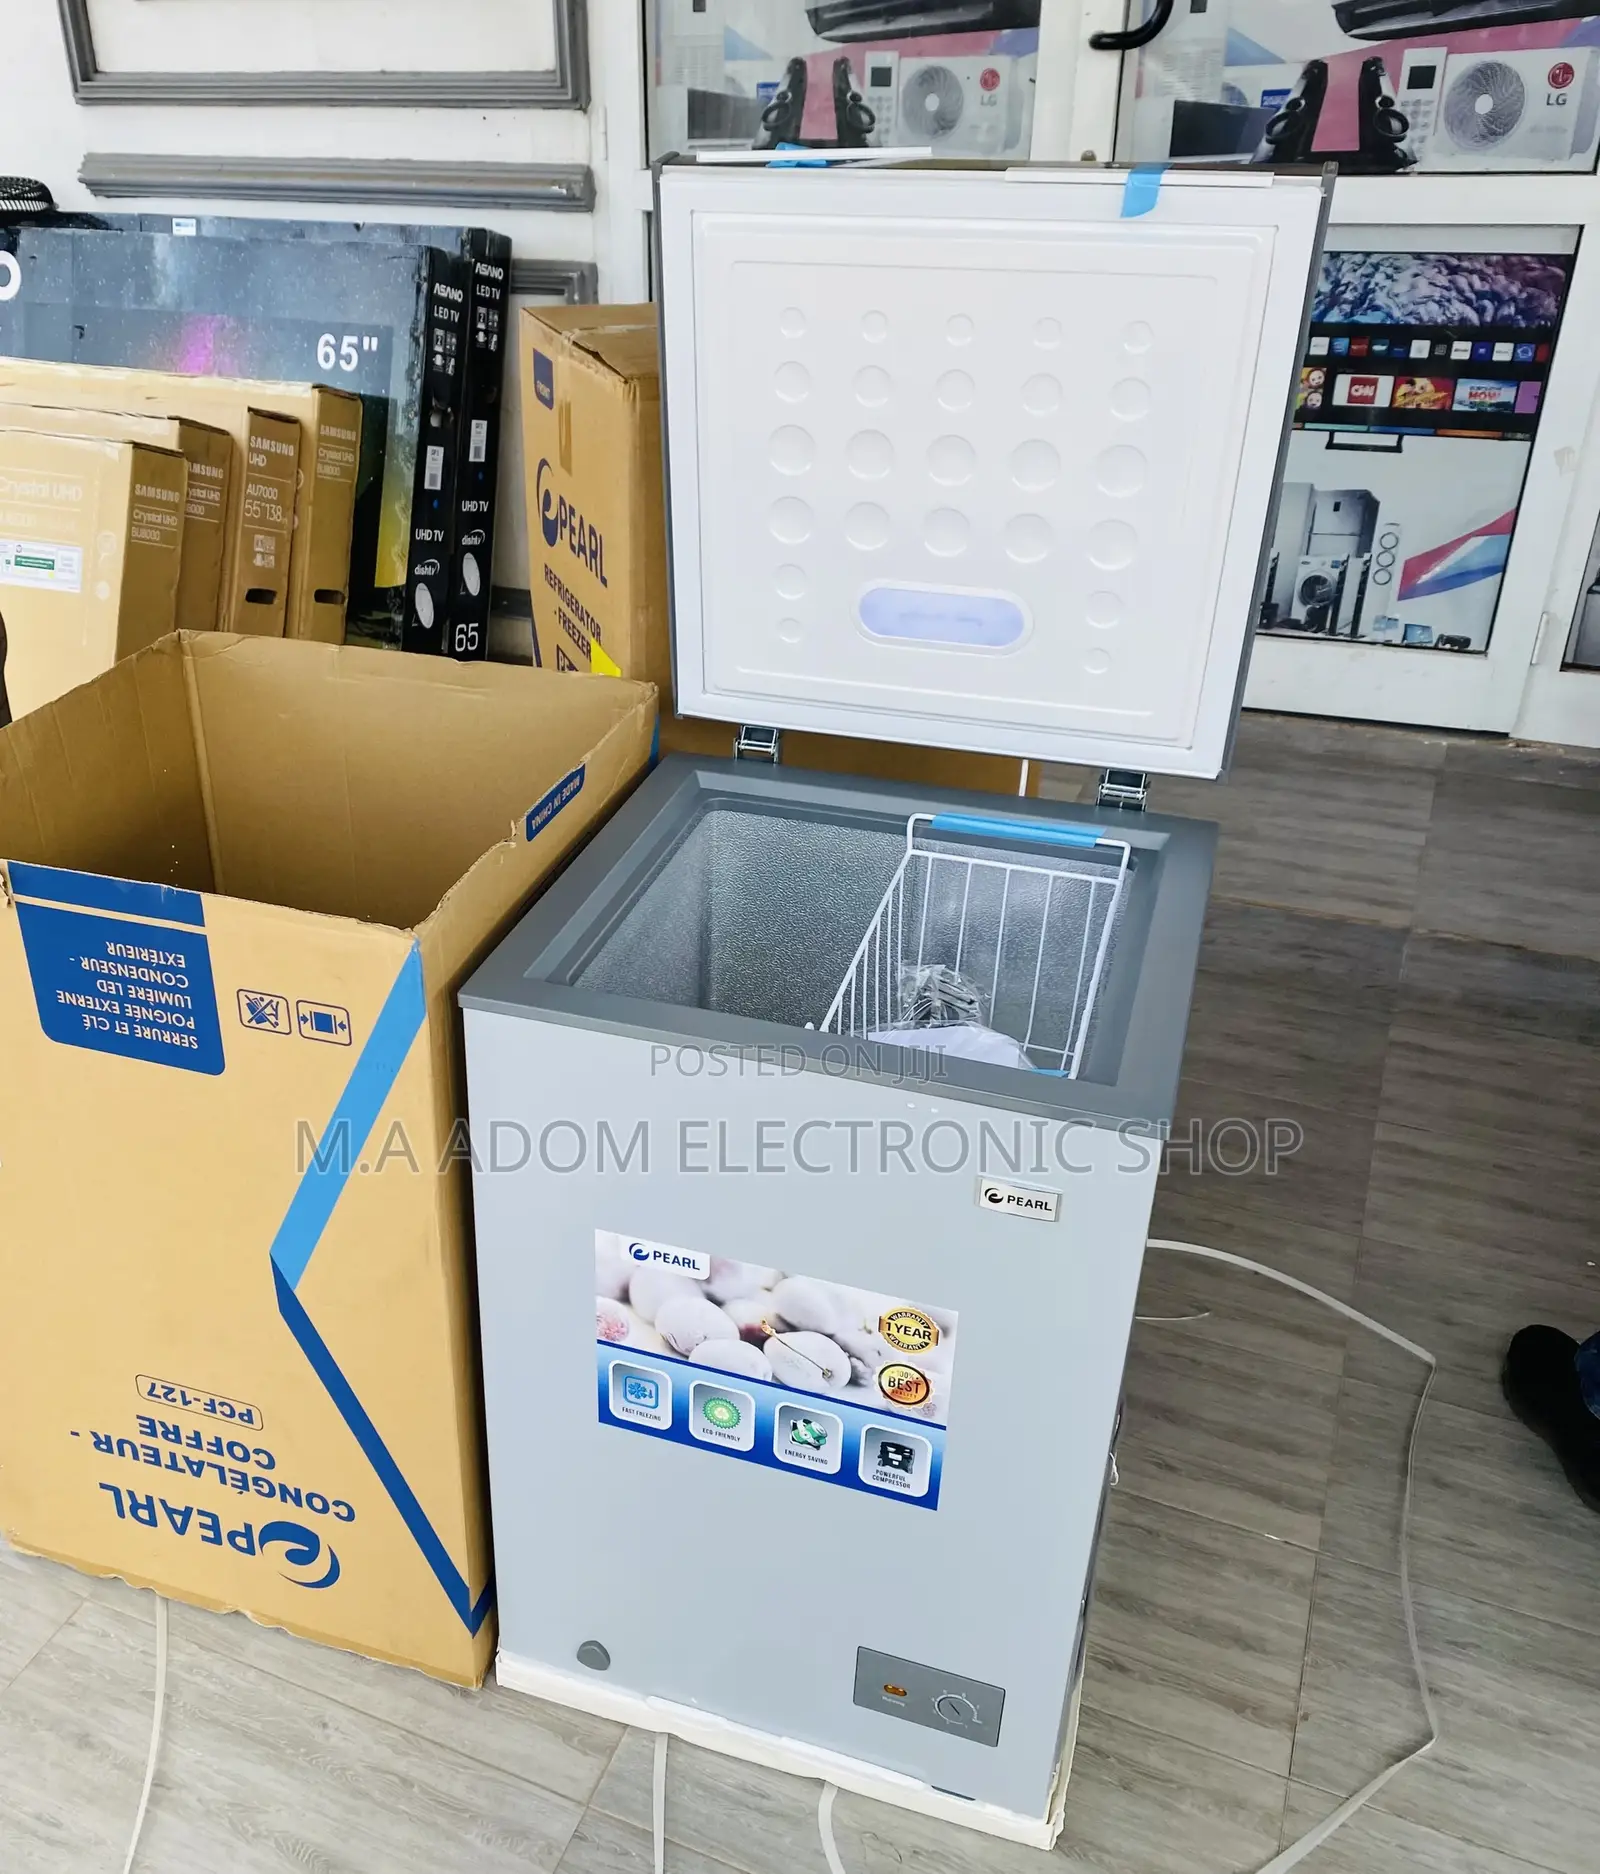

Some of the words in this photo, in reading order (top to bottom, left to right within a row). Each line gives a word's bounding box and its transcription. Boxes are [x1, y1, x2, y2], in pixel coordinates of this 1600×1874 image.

[1546, 93, 1568, 106] LG
[475, 262, 503, 280] ASANO
[433, 283, 463, 303] ASANO
[476, 284, 490, 297] LED
[491, 287, 500, 300] TV
[434, 305, 449, 319] LED
[450, 310, 460, 323] TV
[316, 333, 378, 372] 65"
[320, 424, 356, 441] SAMSUNG
[250, 436, 294, 457] SAMSUNG
[249, 452, 267, 467] UHD
[188, 462, 223, 479] AMSUNG
[134, 484, 180, 502] SAMSUNG
[246, 484, 278, 500] AU7000
[462, 501, 478, 512] UHD
[479, 501, 489, 512] TV
[133, 509, 163, 525] Crystal
[163, 515, 178, 526] UHD
[415, 528, 432, 541] UHD
[434, 530, 444, 542] TV
[559, 494, 608, 588] PEARL
[544, 562, 601, 646] REFRIGERATOR
[455, 623, 479, 652] 65
[558, 606, 592, 663] FREEZER
[562, 776, 580, 800] MADE
[553, 793, 561, 809] IN
[532, 802, 552, 830] CHINA
[106, 941, 186, 968] EXTÉRIEUR
[81, 956, 189, 988] CONDENSEUR
[96, 979, 124, 997] LED
[57, 989, 121, 1014] EXTERNE
[128, 986, 192, 1009] LUMIÈRE
[83, 1013, 111, 1032] CLÉ
[125, 1005, 196, 1030] POIGNÉE
[114, 1020, 129, 1036] ET
[135, 1024, 199, 1049] SERRURE
[1007, 1194, 1053, 1212] PEARL
[653, 1250, 701, 1271] PEARL
[890, 1311, 929, 1329] WARRANTY
[886, 1321, 892, 1331] 1
[894, 1323, 932, 1341] YEAR
[889, 1334, 926, 1350] WARRANTY
[888, 1376, 921, 1394] BEST
[146, 1380, 255, 1426] PCF-127
[622, 1406, 635, 1415] FAST
[635, 1409, 661, 1421] FREEZING
[136, 1414, 276, 1470] COFFRE
[702, 1427, 713, 1436] ECO
[714, 1430, 741, 1443] FRIENDLY
[785, 1448, 807, 1460] ENERGY
[808, 1454, 828, 1465] SAVING
[91, 1429, 356, 1523] CONGÉLATEUR
[872, 1475, 911, 1489] COMPRESSOR
[875, 1469, 906, 1482] POWERFUL
[98, 1482, 257, 1557] PEARL
